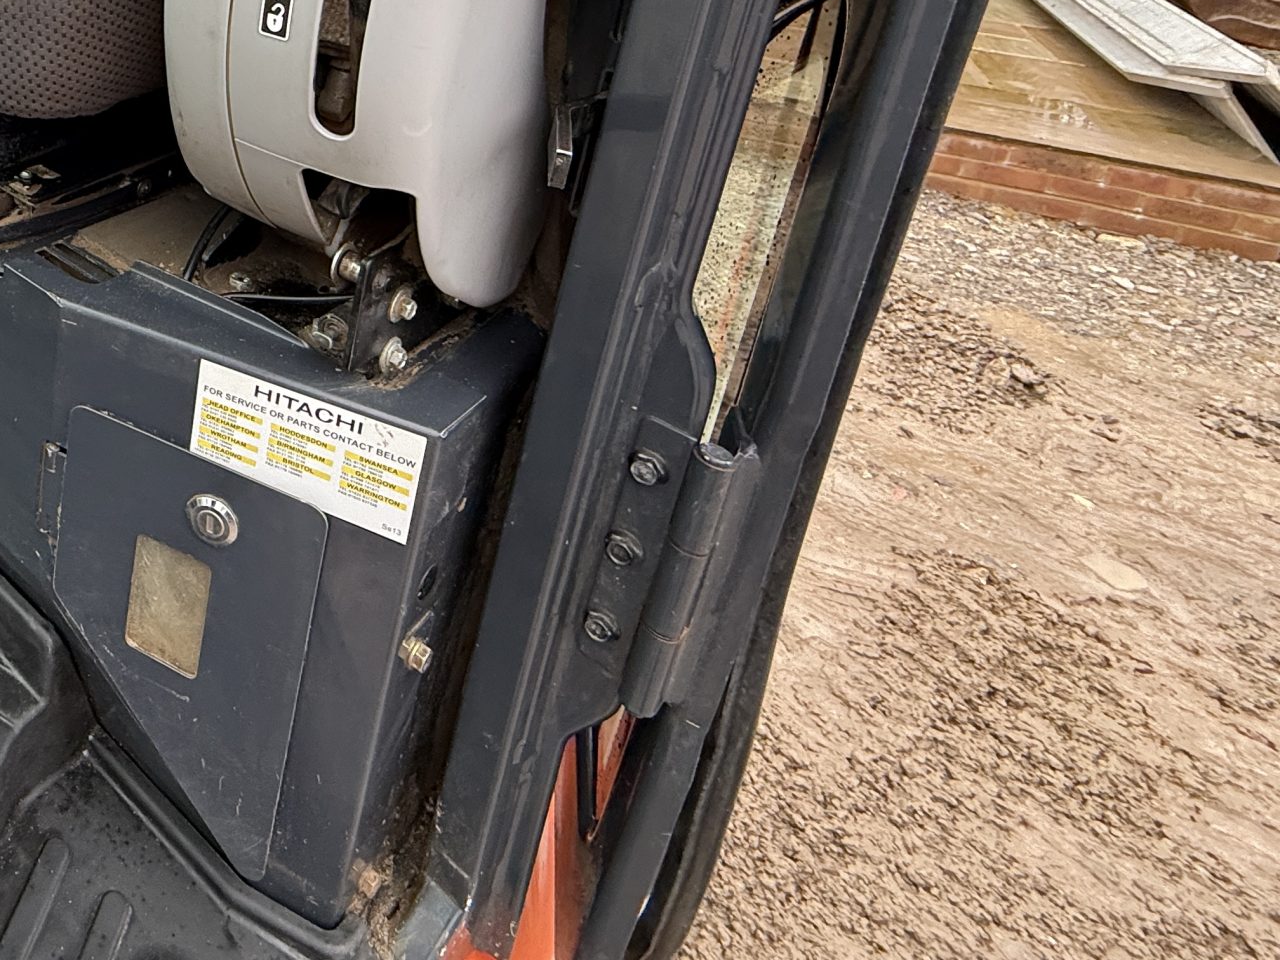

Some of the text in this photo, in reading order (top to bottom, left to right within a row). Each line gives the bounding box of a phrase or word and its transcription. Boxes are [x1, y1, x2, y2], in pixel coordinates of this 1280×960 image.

[209, 400, 229, 411] HEAD
[230, 408, 256, 422] OFFICE
[254, 385, 363, 434] HITACHI
[204, 385, 222, 398] FOR
[226, 393, 267, 414] SERVICE
[269, 409, 284, 421] OR
[287, 416, 320, 433] PARTS
[323, 429, 374, 453] CONTACT
[376, 448, 416, 469] BELOW
[206, 414, 256, 437] OKEHAMPTON
[210, 430, 247, 448] WROTHAM
[280, 426, 327, 448] HODDESDON
[211, 444, 242, 460] READING
[276, 440, 326, 463] BIRMINGHAM
[282, 458, 314, 474] BRISTOL
[359, 456, 398, 475] SWANSEA
[355, 470, 396, 490] GLASGOW
[347, 483, 400, 508] WARRINGTON
